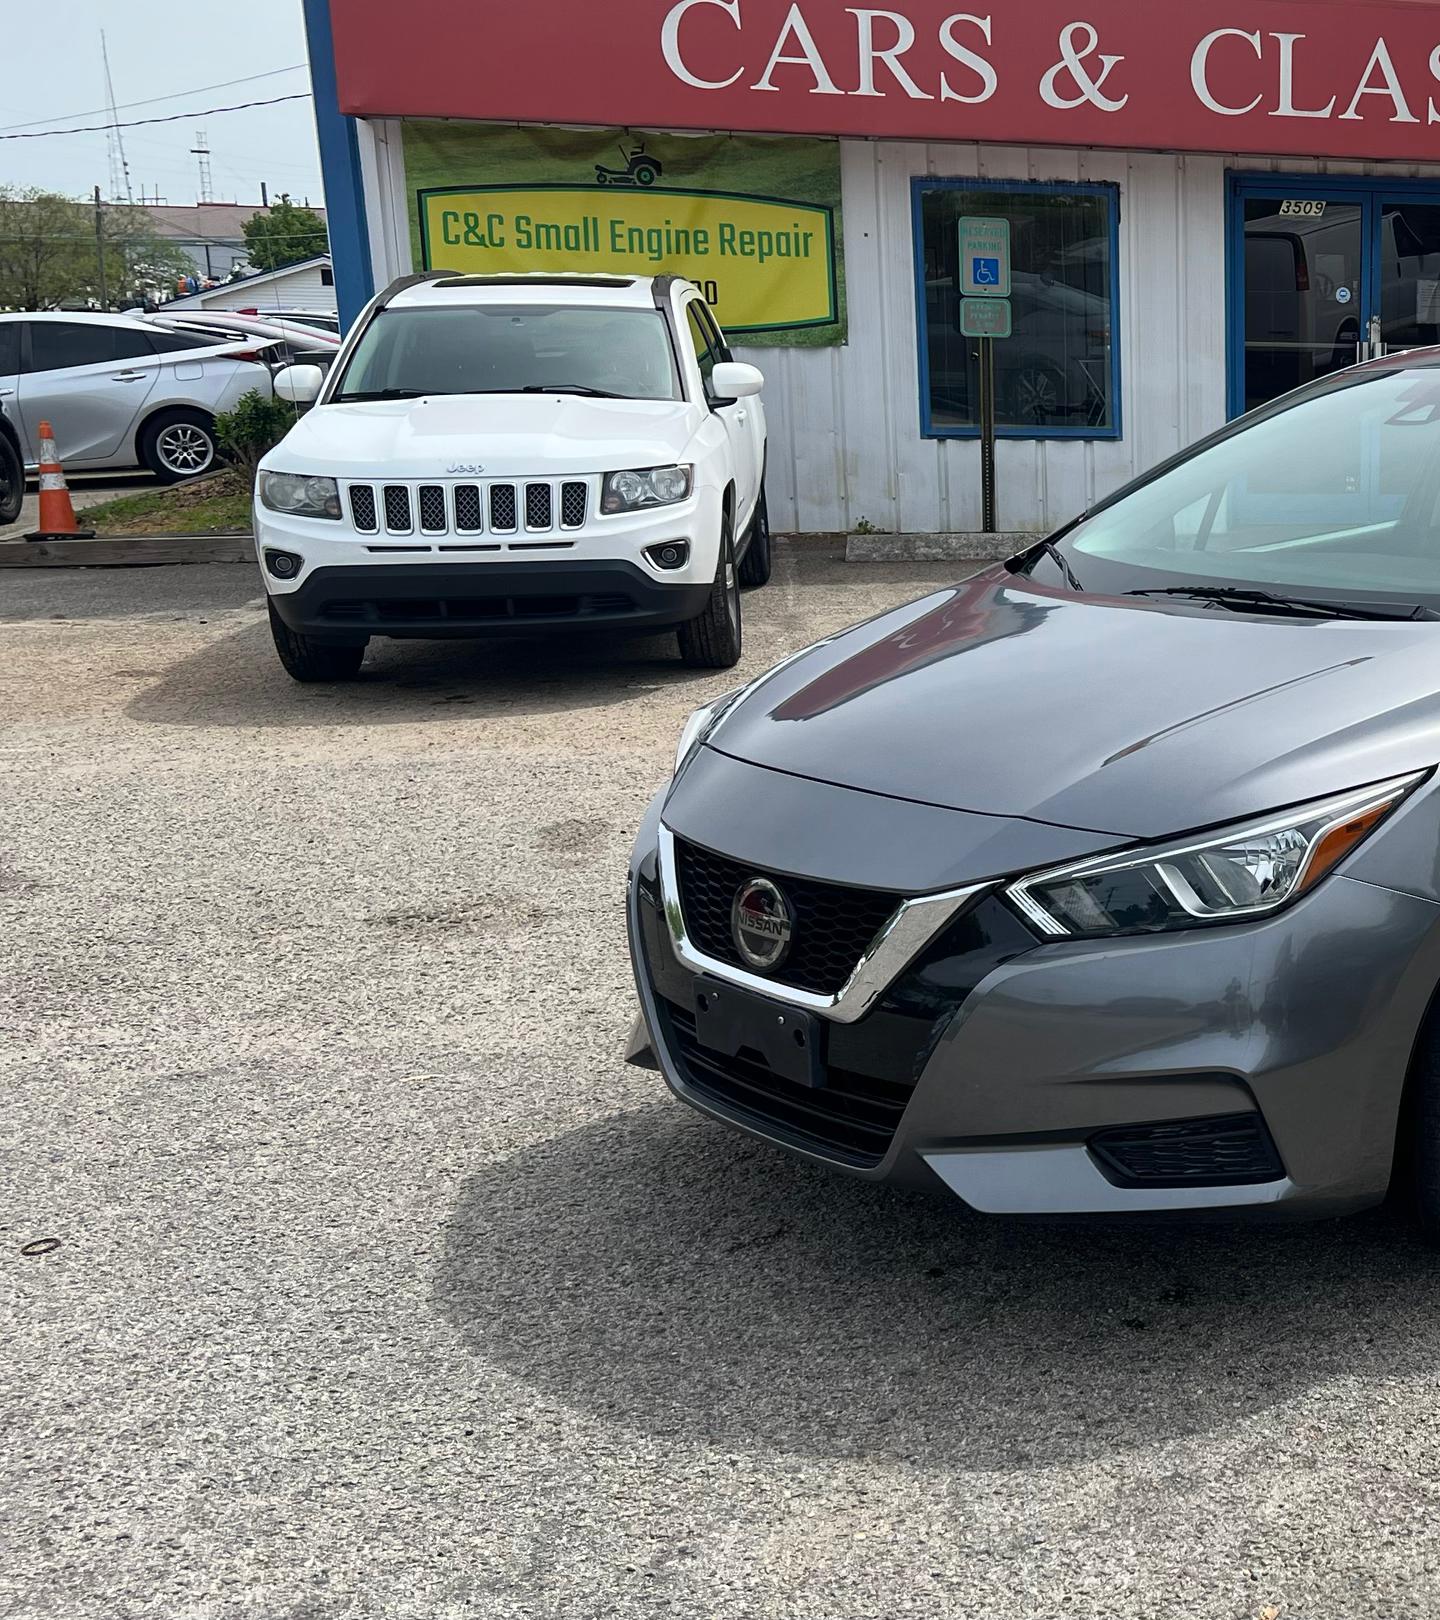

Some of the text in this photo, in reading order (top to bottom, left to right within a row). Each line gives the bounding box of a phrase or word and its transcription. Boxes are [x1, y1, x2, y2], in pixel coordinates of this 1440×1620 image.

[660, 0, 999, 104] CARS
[1038, 21, 1129, 113] &
[1281, 200, 1323, 214] 3509
[442, 210, 813, 263] C&C Small Engine Repair
[446, 462, 485, 475] Jeep
[738, 910, 783, 936] NISSAN
